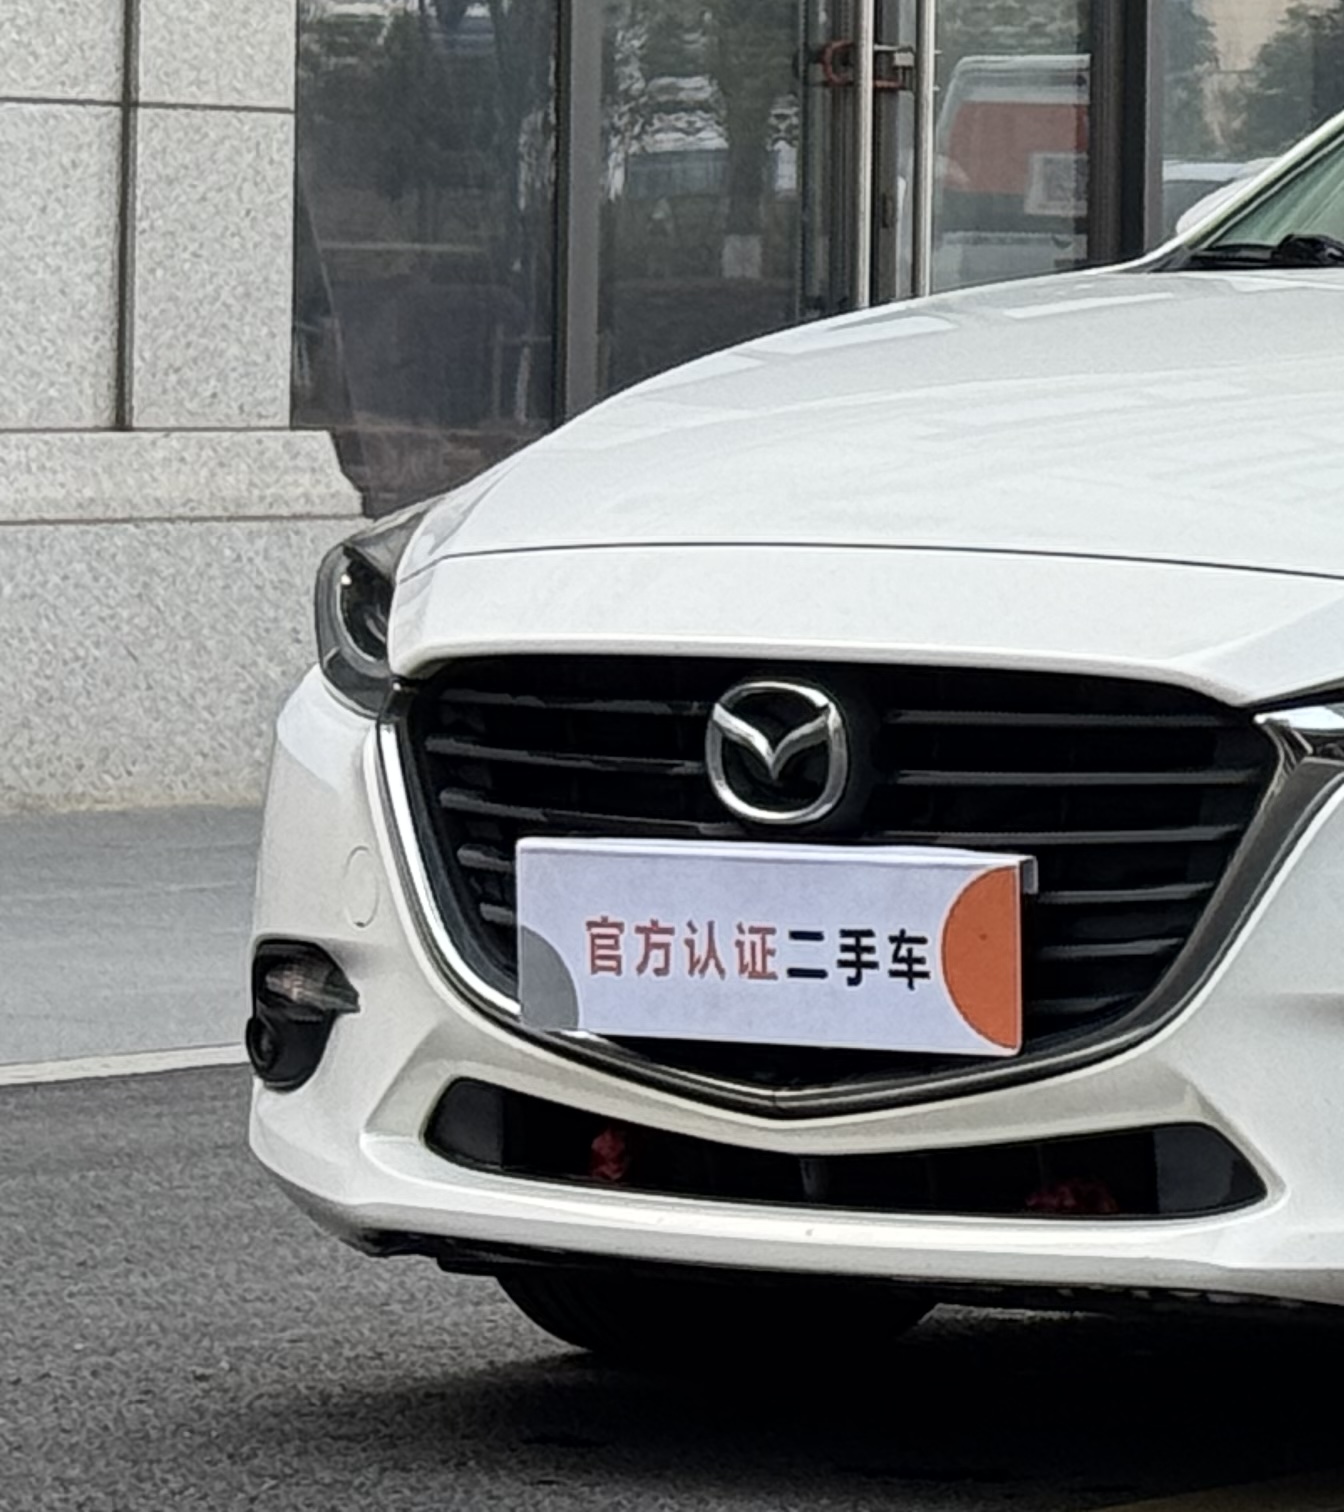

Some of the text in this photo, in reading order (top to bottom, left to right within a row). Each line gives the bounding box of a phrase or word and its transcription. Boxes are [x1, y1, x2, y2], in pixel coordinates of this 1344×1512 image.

[585, 916, 931, 990] 官方认证二手车
